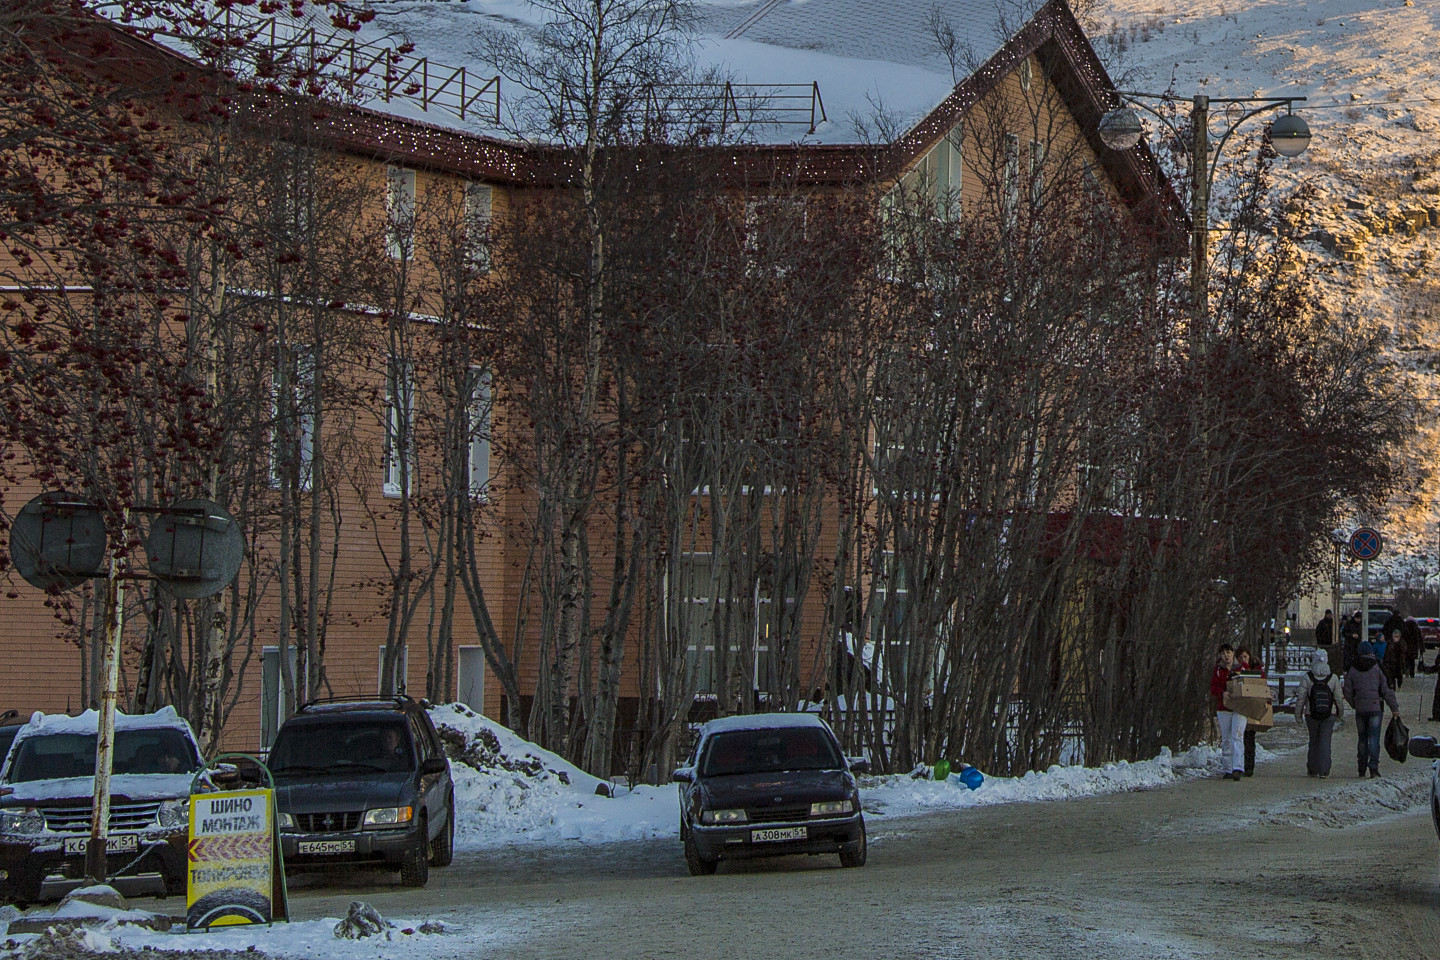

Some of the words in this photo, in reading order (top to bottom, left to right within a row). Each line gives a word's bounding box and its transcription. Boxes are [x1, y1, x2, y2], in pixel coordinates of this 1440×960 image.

[211, 798, 252, 814] ШИНО
[202, 815, 261, 833] МОНТАЖ
[121, 836, 134, 846] 51
[755, 830, 792, 842] А308МК
[794, 828, 804, 836] 51
[302, 842, 340, 853] Е645МС
[342, 841, 353, 849] 51
